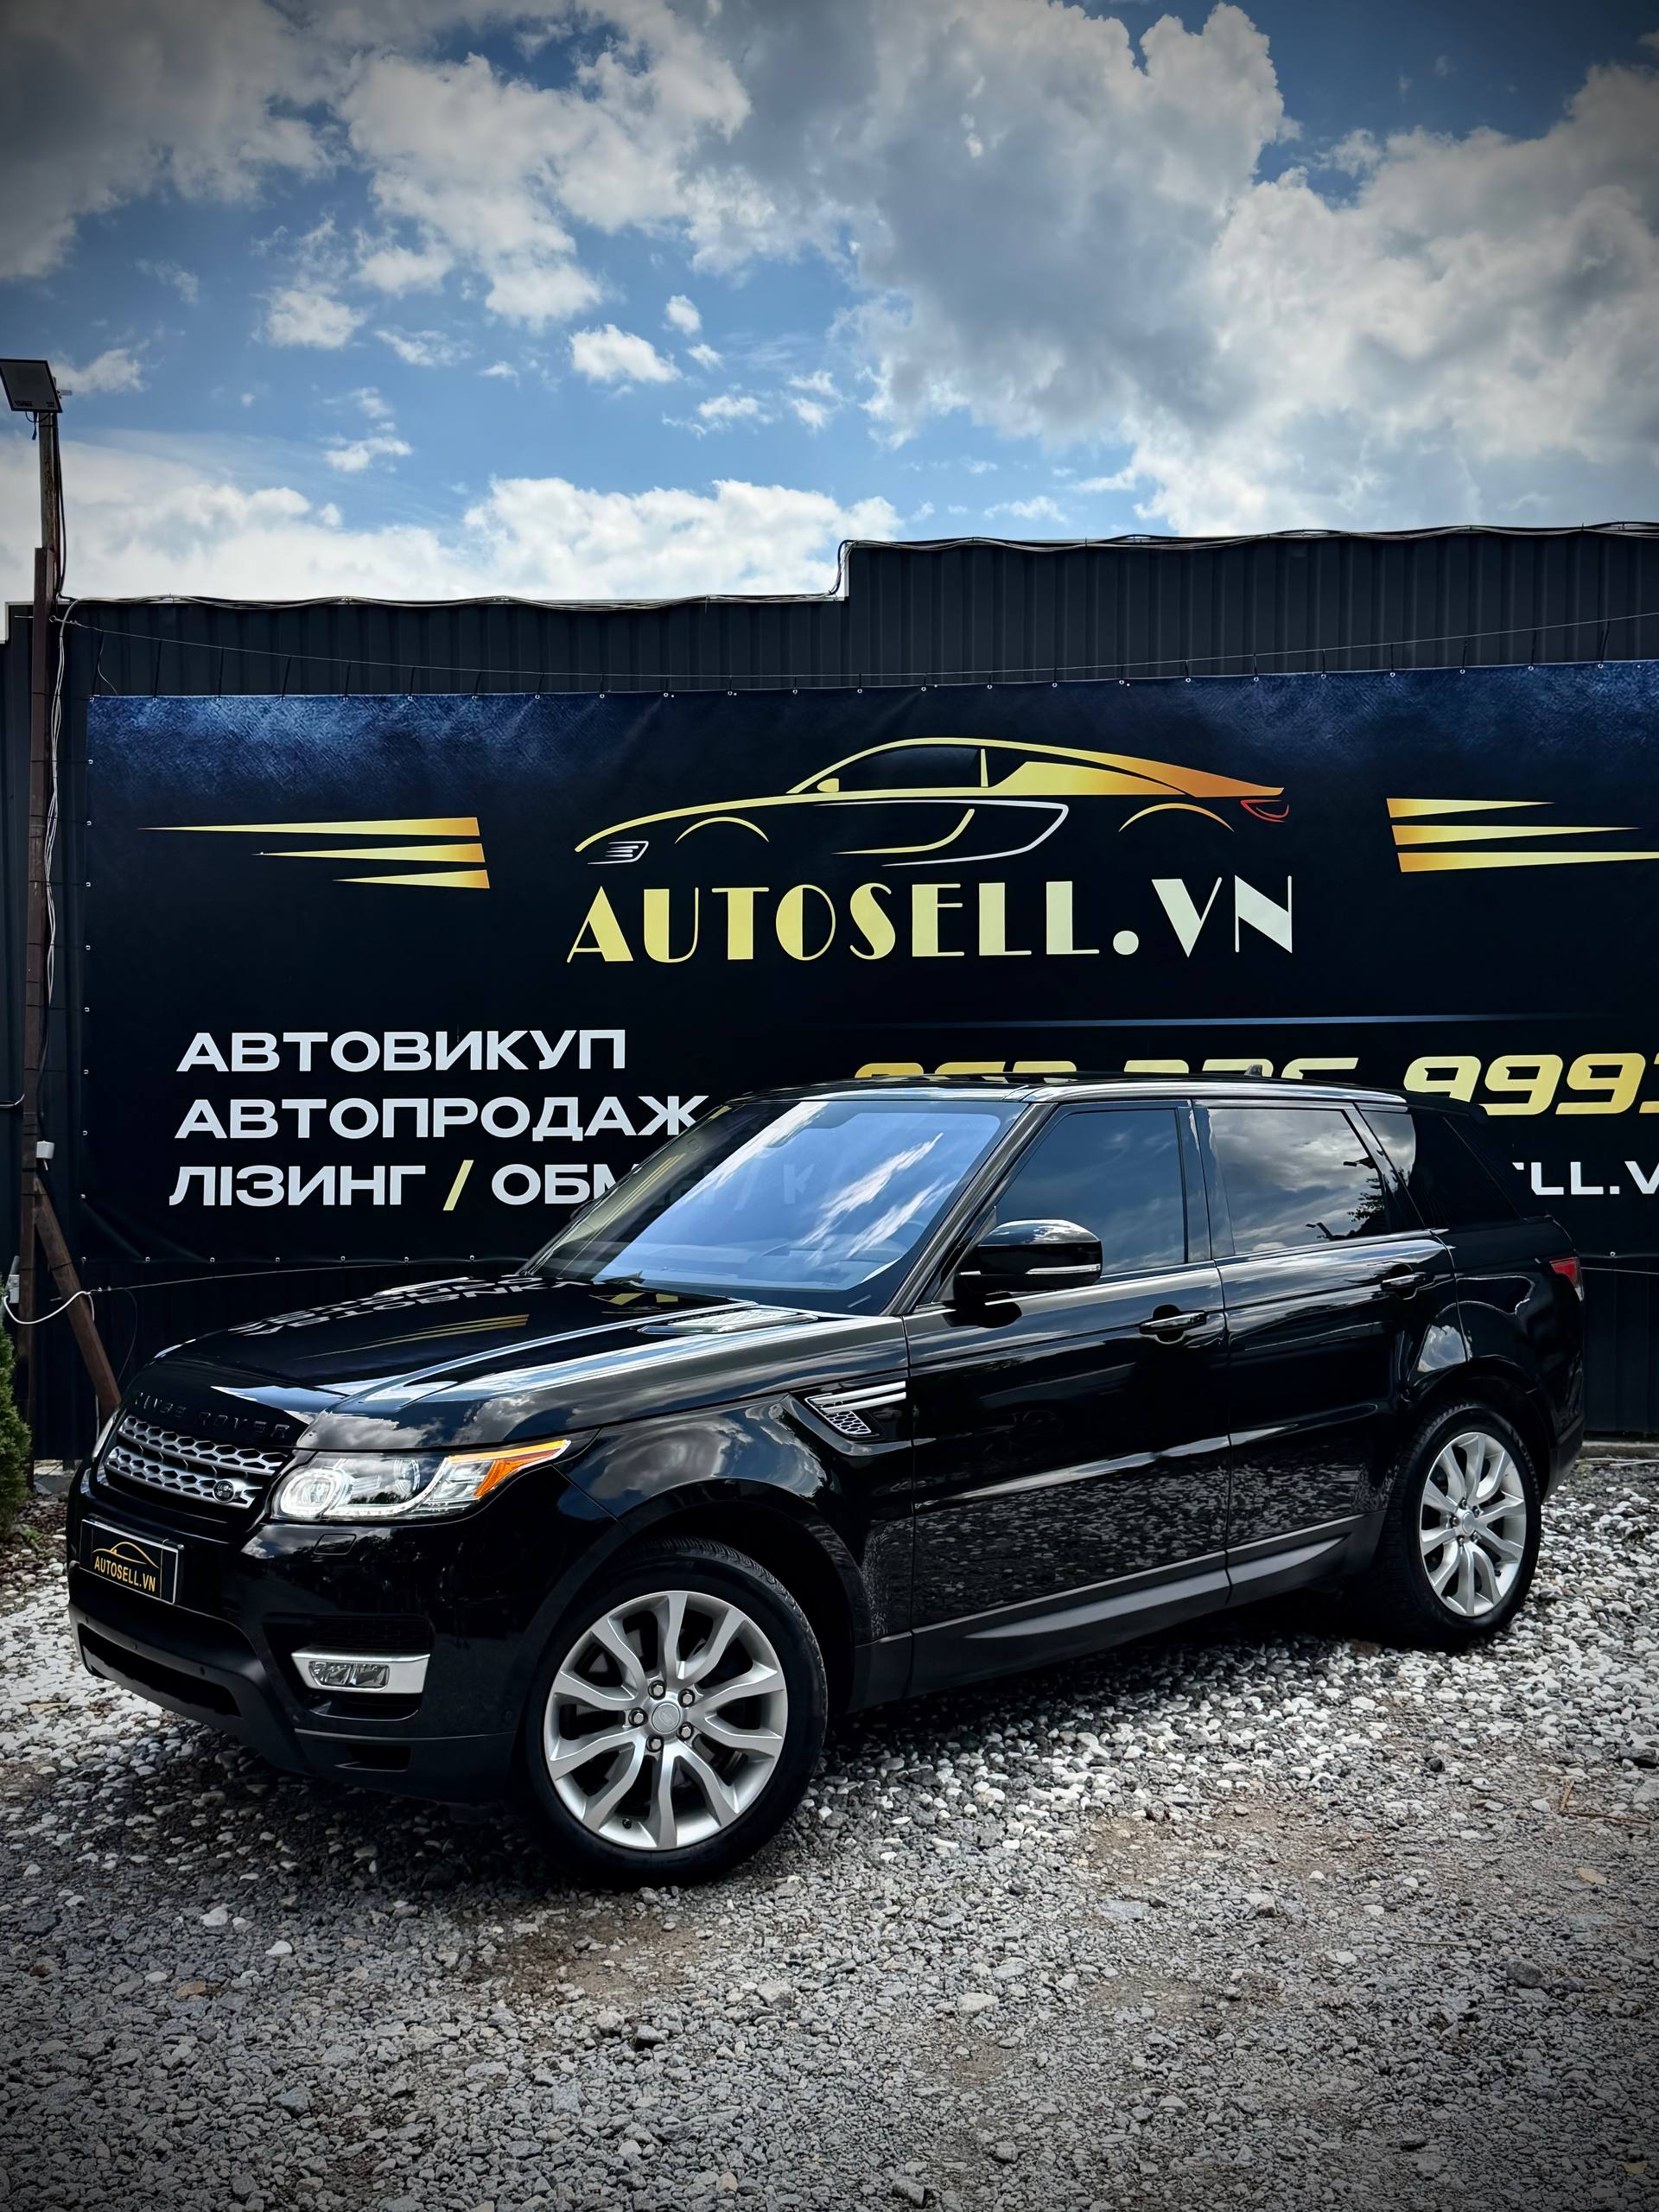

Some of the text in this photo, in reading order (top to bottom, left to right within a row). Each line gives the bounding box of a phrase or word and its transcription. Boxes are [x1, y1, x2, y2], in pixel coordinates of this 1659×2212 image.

[567, 874, 1294, 963] AUTOSELL.VN
[176, 1029, 626, 1072] АВТОВИКУП
[1403, 1052, 1659, 1116] 999
[175, 1095, 709, 1141] АВТОПРОДАЖ
[168, 1165, 426, 1206] ЛІЗИНГ
[94, 1555, 156, 1592] AUTOSELL.VN
